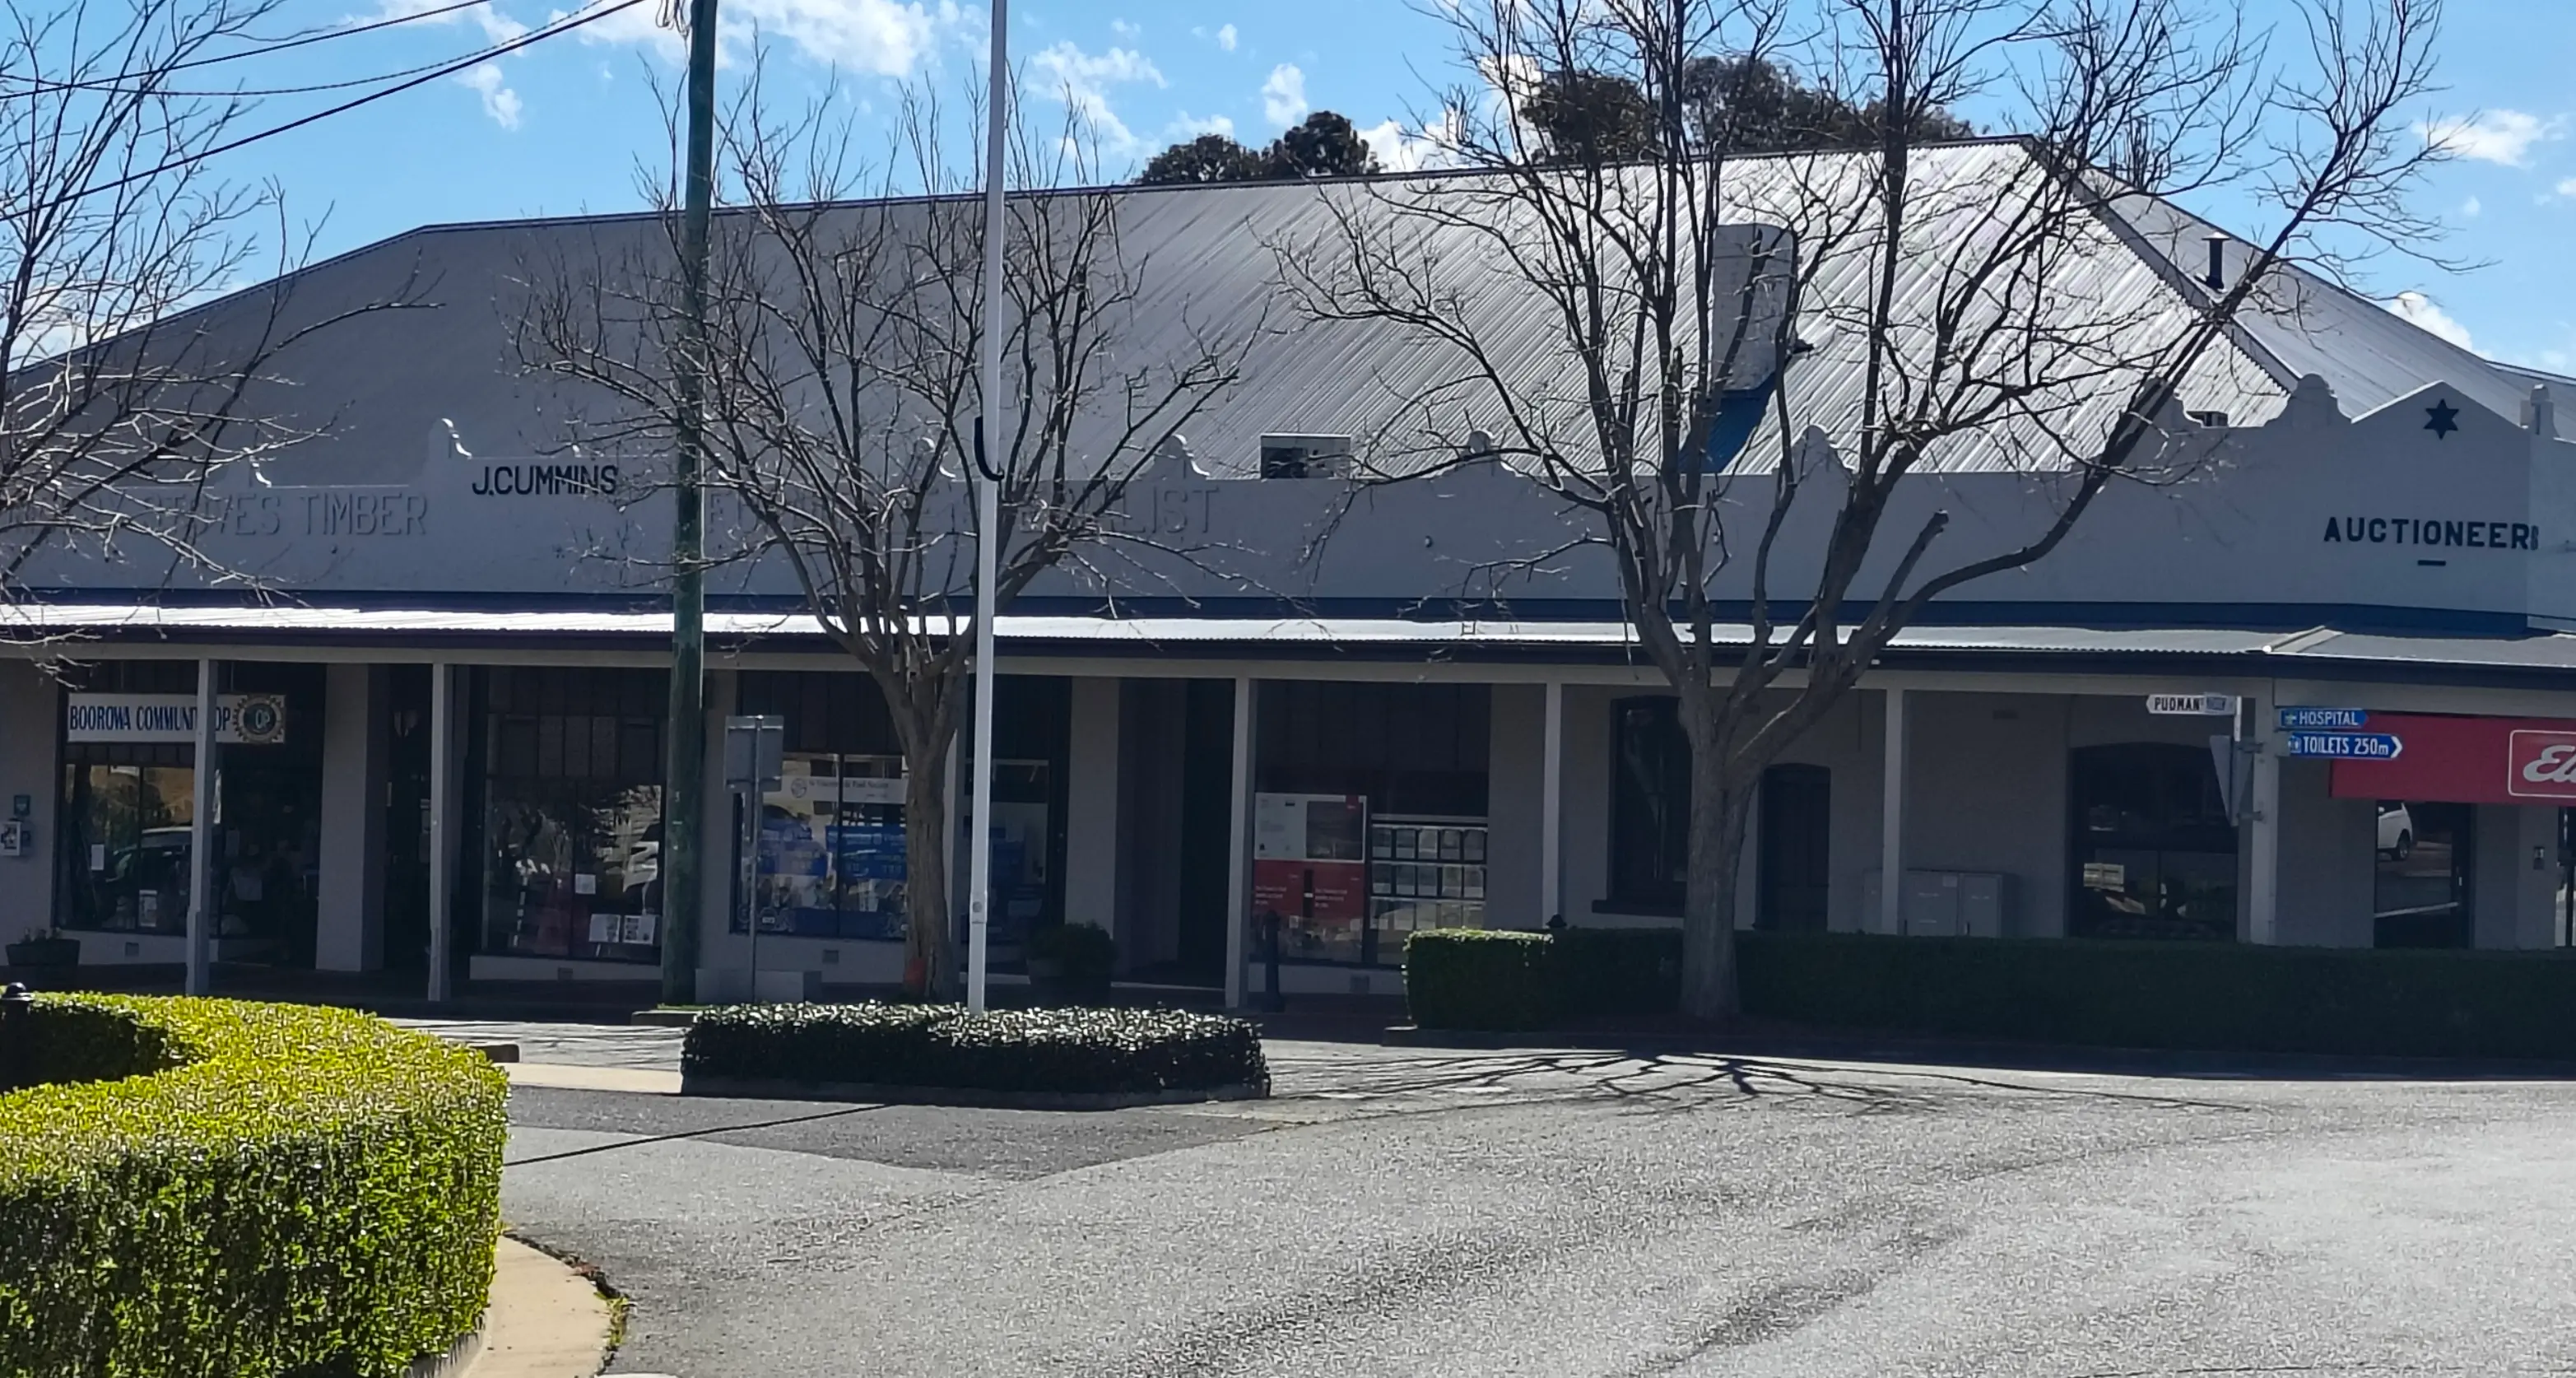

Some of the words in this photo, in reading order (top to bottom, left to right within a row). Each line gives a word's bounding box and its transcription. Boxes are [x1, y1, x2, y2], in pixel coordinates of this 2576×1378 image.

[472, 465, 617, 496] J.CUMMINS
[300, 493, 428, 536] TIMBER
[2323, 516, 2539, 551] AUCTIONEERS
[2155, 696, 2200, 712] PUDMAN
[69, 705, 131, 731] BOOROWA
[136, 705, 198, 731] COMMUN
[2299, 711, 2360, 726] HOSPITAL
[2303, 736, 2350, 754] TOILETS
[2354, 738, 2389, 756] 250m
